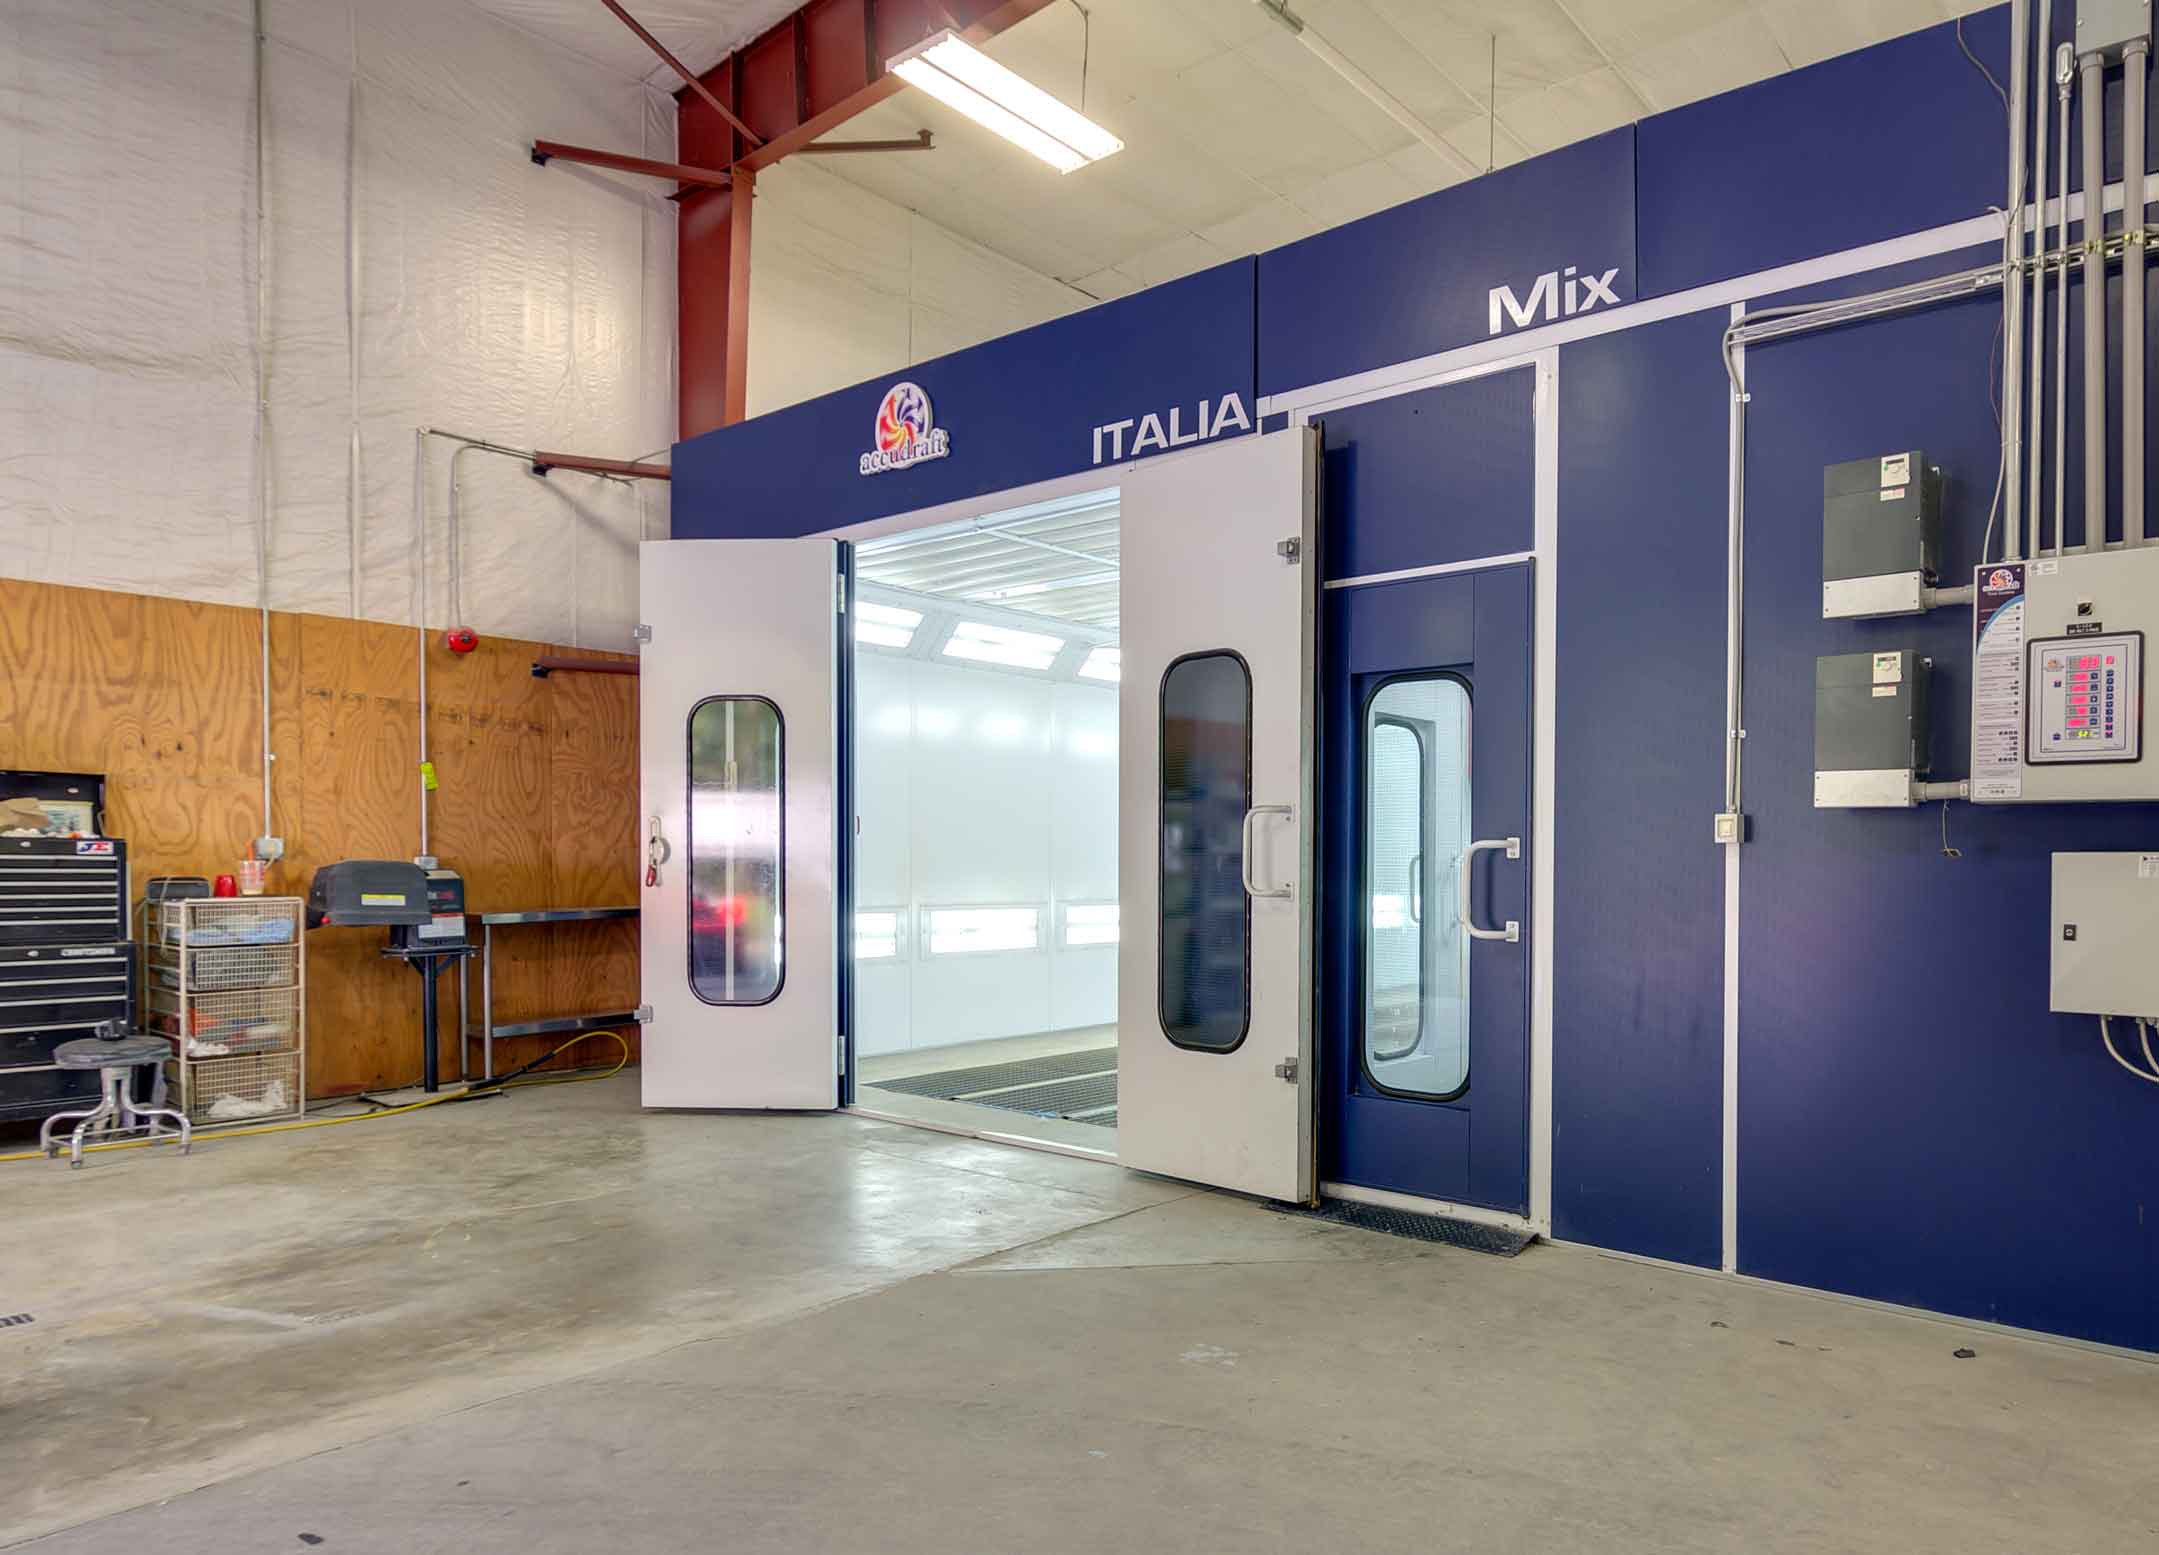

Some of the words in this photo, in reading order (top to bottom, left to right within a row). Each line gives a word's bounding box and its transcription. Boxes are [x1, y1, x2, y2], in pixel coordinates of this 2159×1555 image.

[1489, 266, 1621, 335] Mix
[861, 429, 946, 473] accudraft
[1093, 392, 1250, 464] ITALIA
